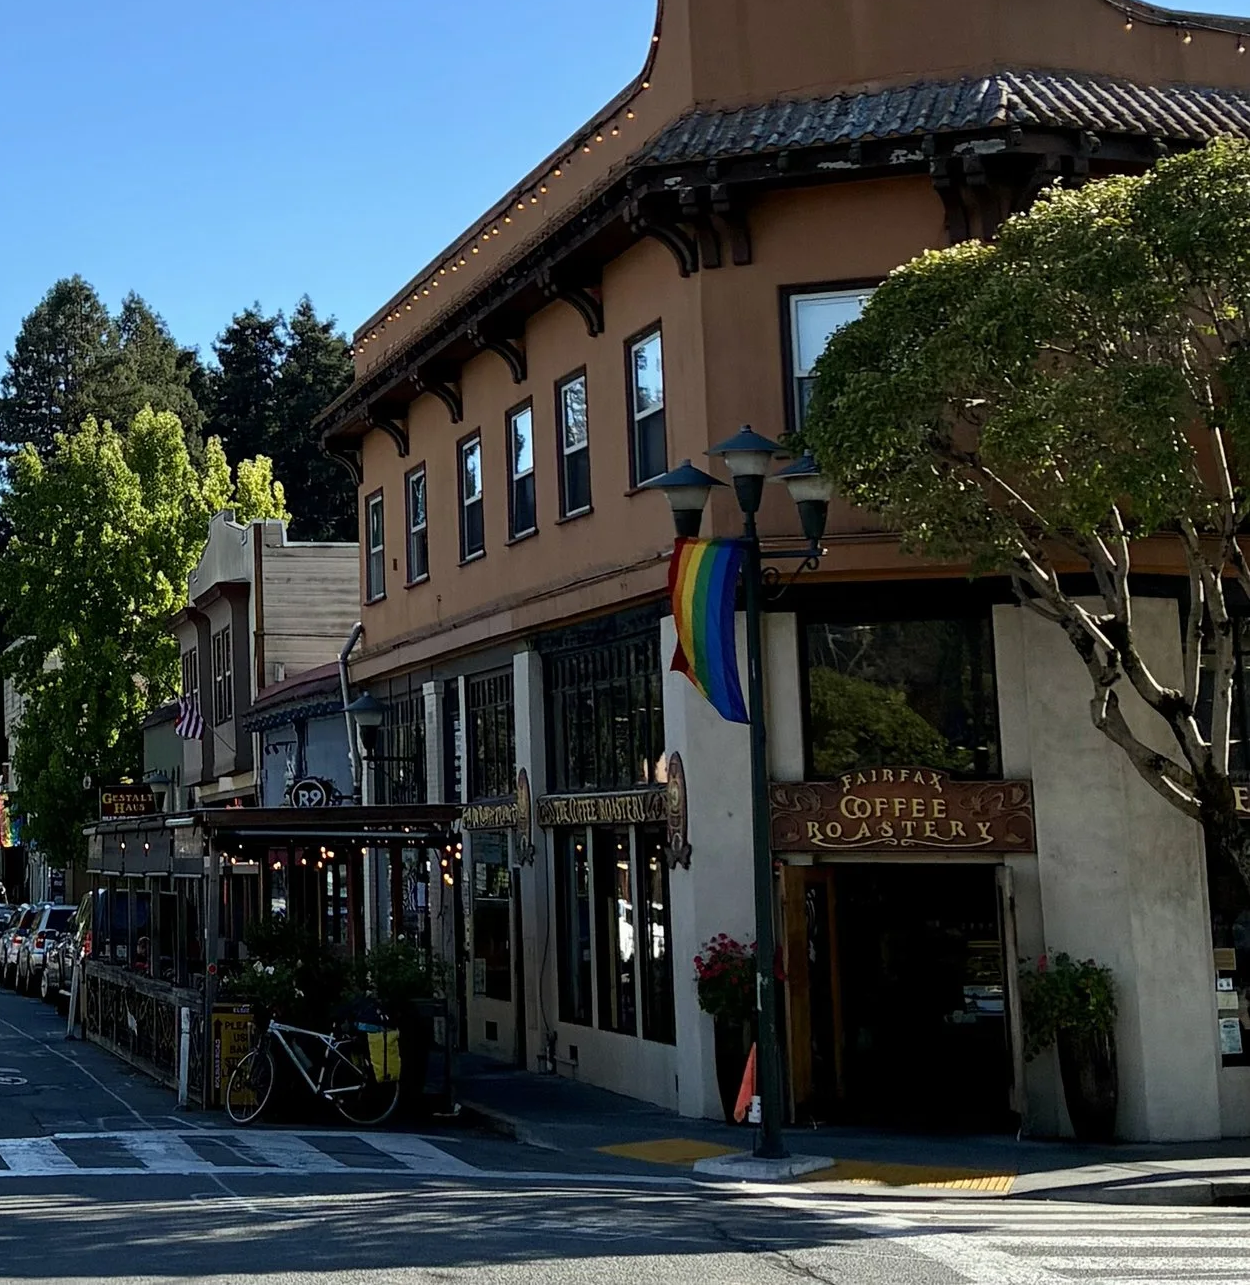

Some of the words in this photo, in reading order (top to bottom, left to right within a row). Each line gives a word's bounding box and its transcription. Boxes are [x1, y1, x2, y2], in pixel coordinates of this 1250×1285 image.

[841, 768, 943, 793] FAIRFAX
[102, 792, 152, 805] GESTALT
[114, 803, 146, 814] HAUS
[298, 790, 323, 809] R9
[569, 797, 597, 822] COFFEE
[597, 794, 645, 822] ROASTERY
[840, 795, 947, 820] COFFEE
[806, 820, 994, 843] ROASTERY
